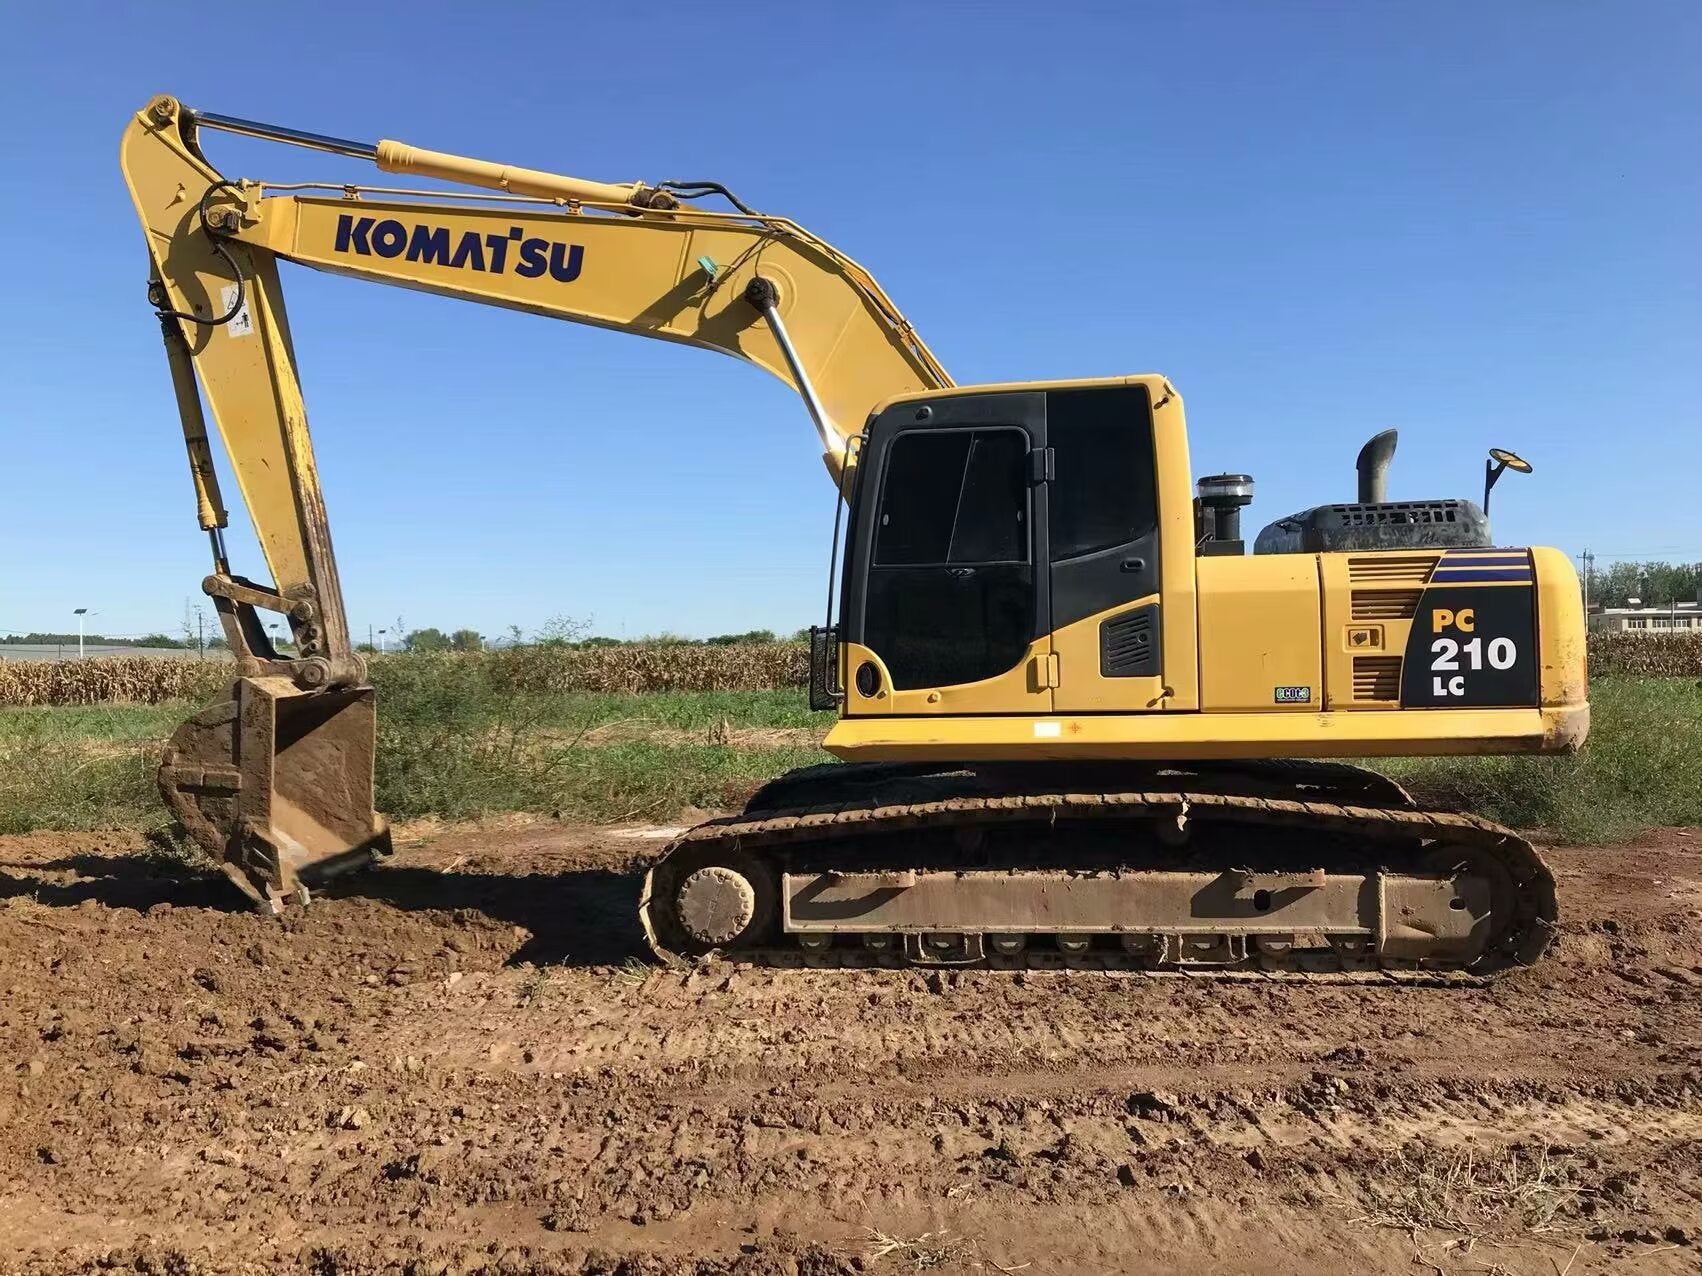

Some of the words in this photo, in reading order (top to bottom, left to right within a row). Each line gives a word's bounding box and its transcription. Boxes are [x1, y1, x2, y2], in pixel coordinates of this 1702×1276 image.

[334, 214, 585, 283] KOMATSU
[1432, 608, 1475, 633] PC
[1431, 637, 1517, 670] 210
[1433, 676, 1465, 696] LC
